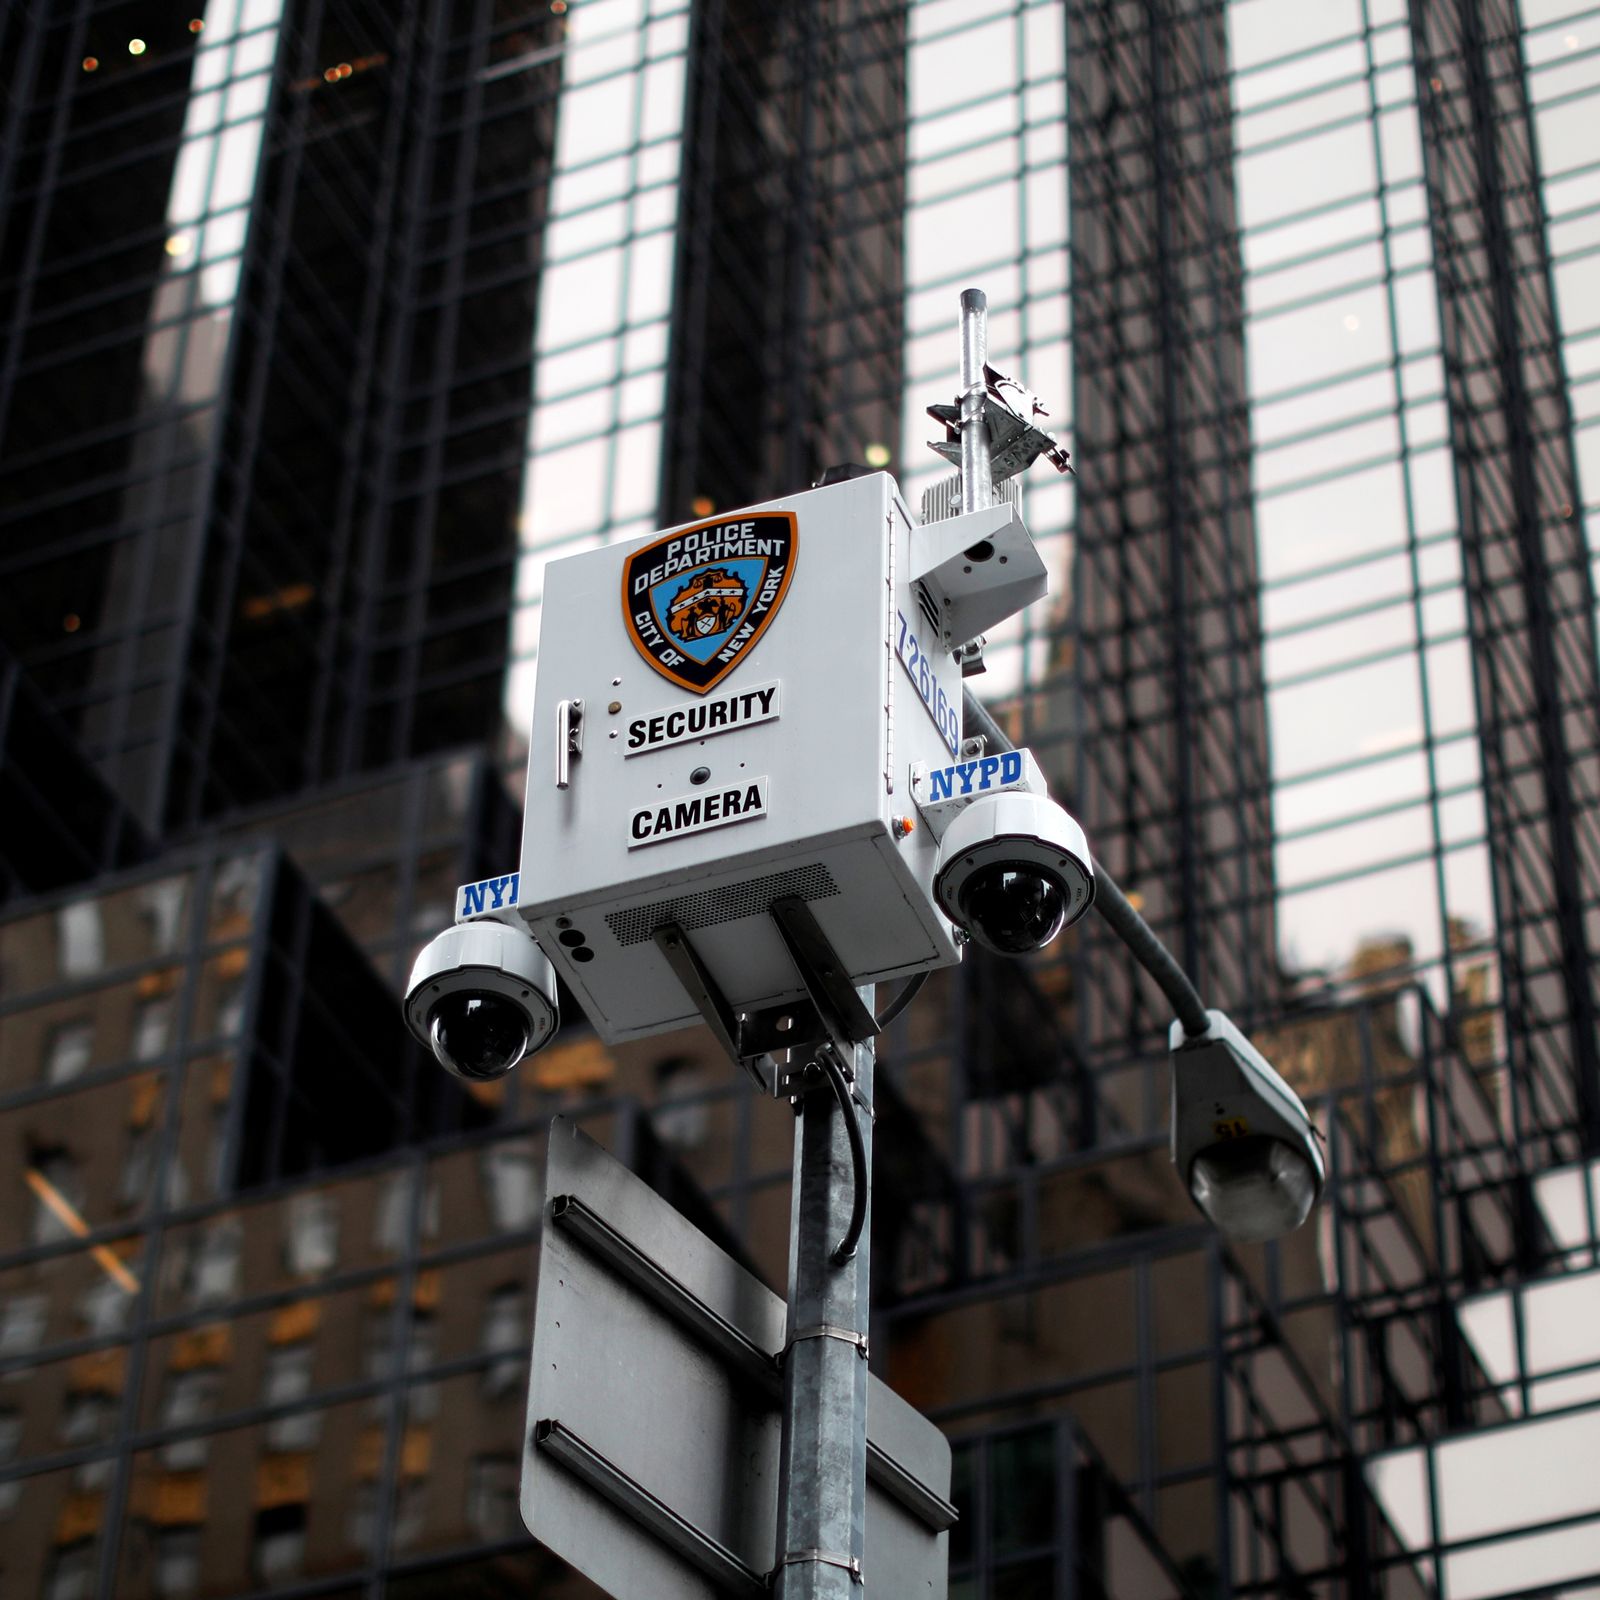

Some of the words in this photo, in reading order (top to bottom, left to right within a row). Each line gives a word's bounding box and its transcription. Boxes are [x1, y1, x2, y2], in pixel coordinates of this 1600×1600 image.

[634, 539, 785, 596] DEPARTMENT
[667, 522, 755, 560] POLICE
[635, 610, 664, 647] CITY
[658, 648, 685, 667] OF
[717, 622, 756, 663] NEW
[752, 565, 785, 614] YORK
[628, 687, 776, 749] SECURITY
[929, 751, 1022, 803] NYPD
[632, 784, 762, 839] CAMERA
[462, 873, 520, 917] NY
